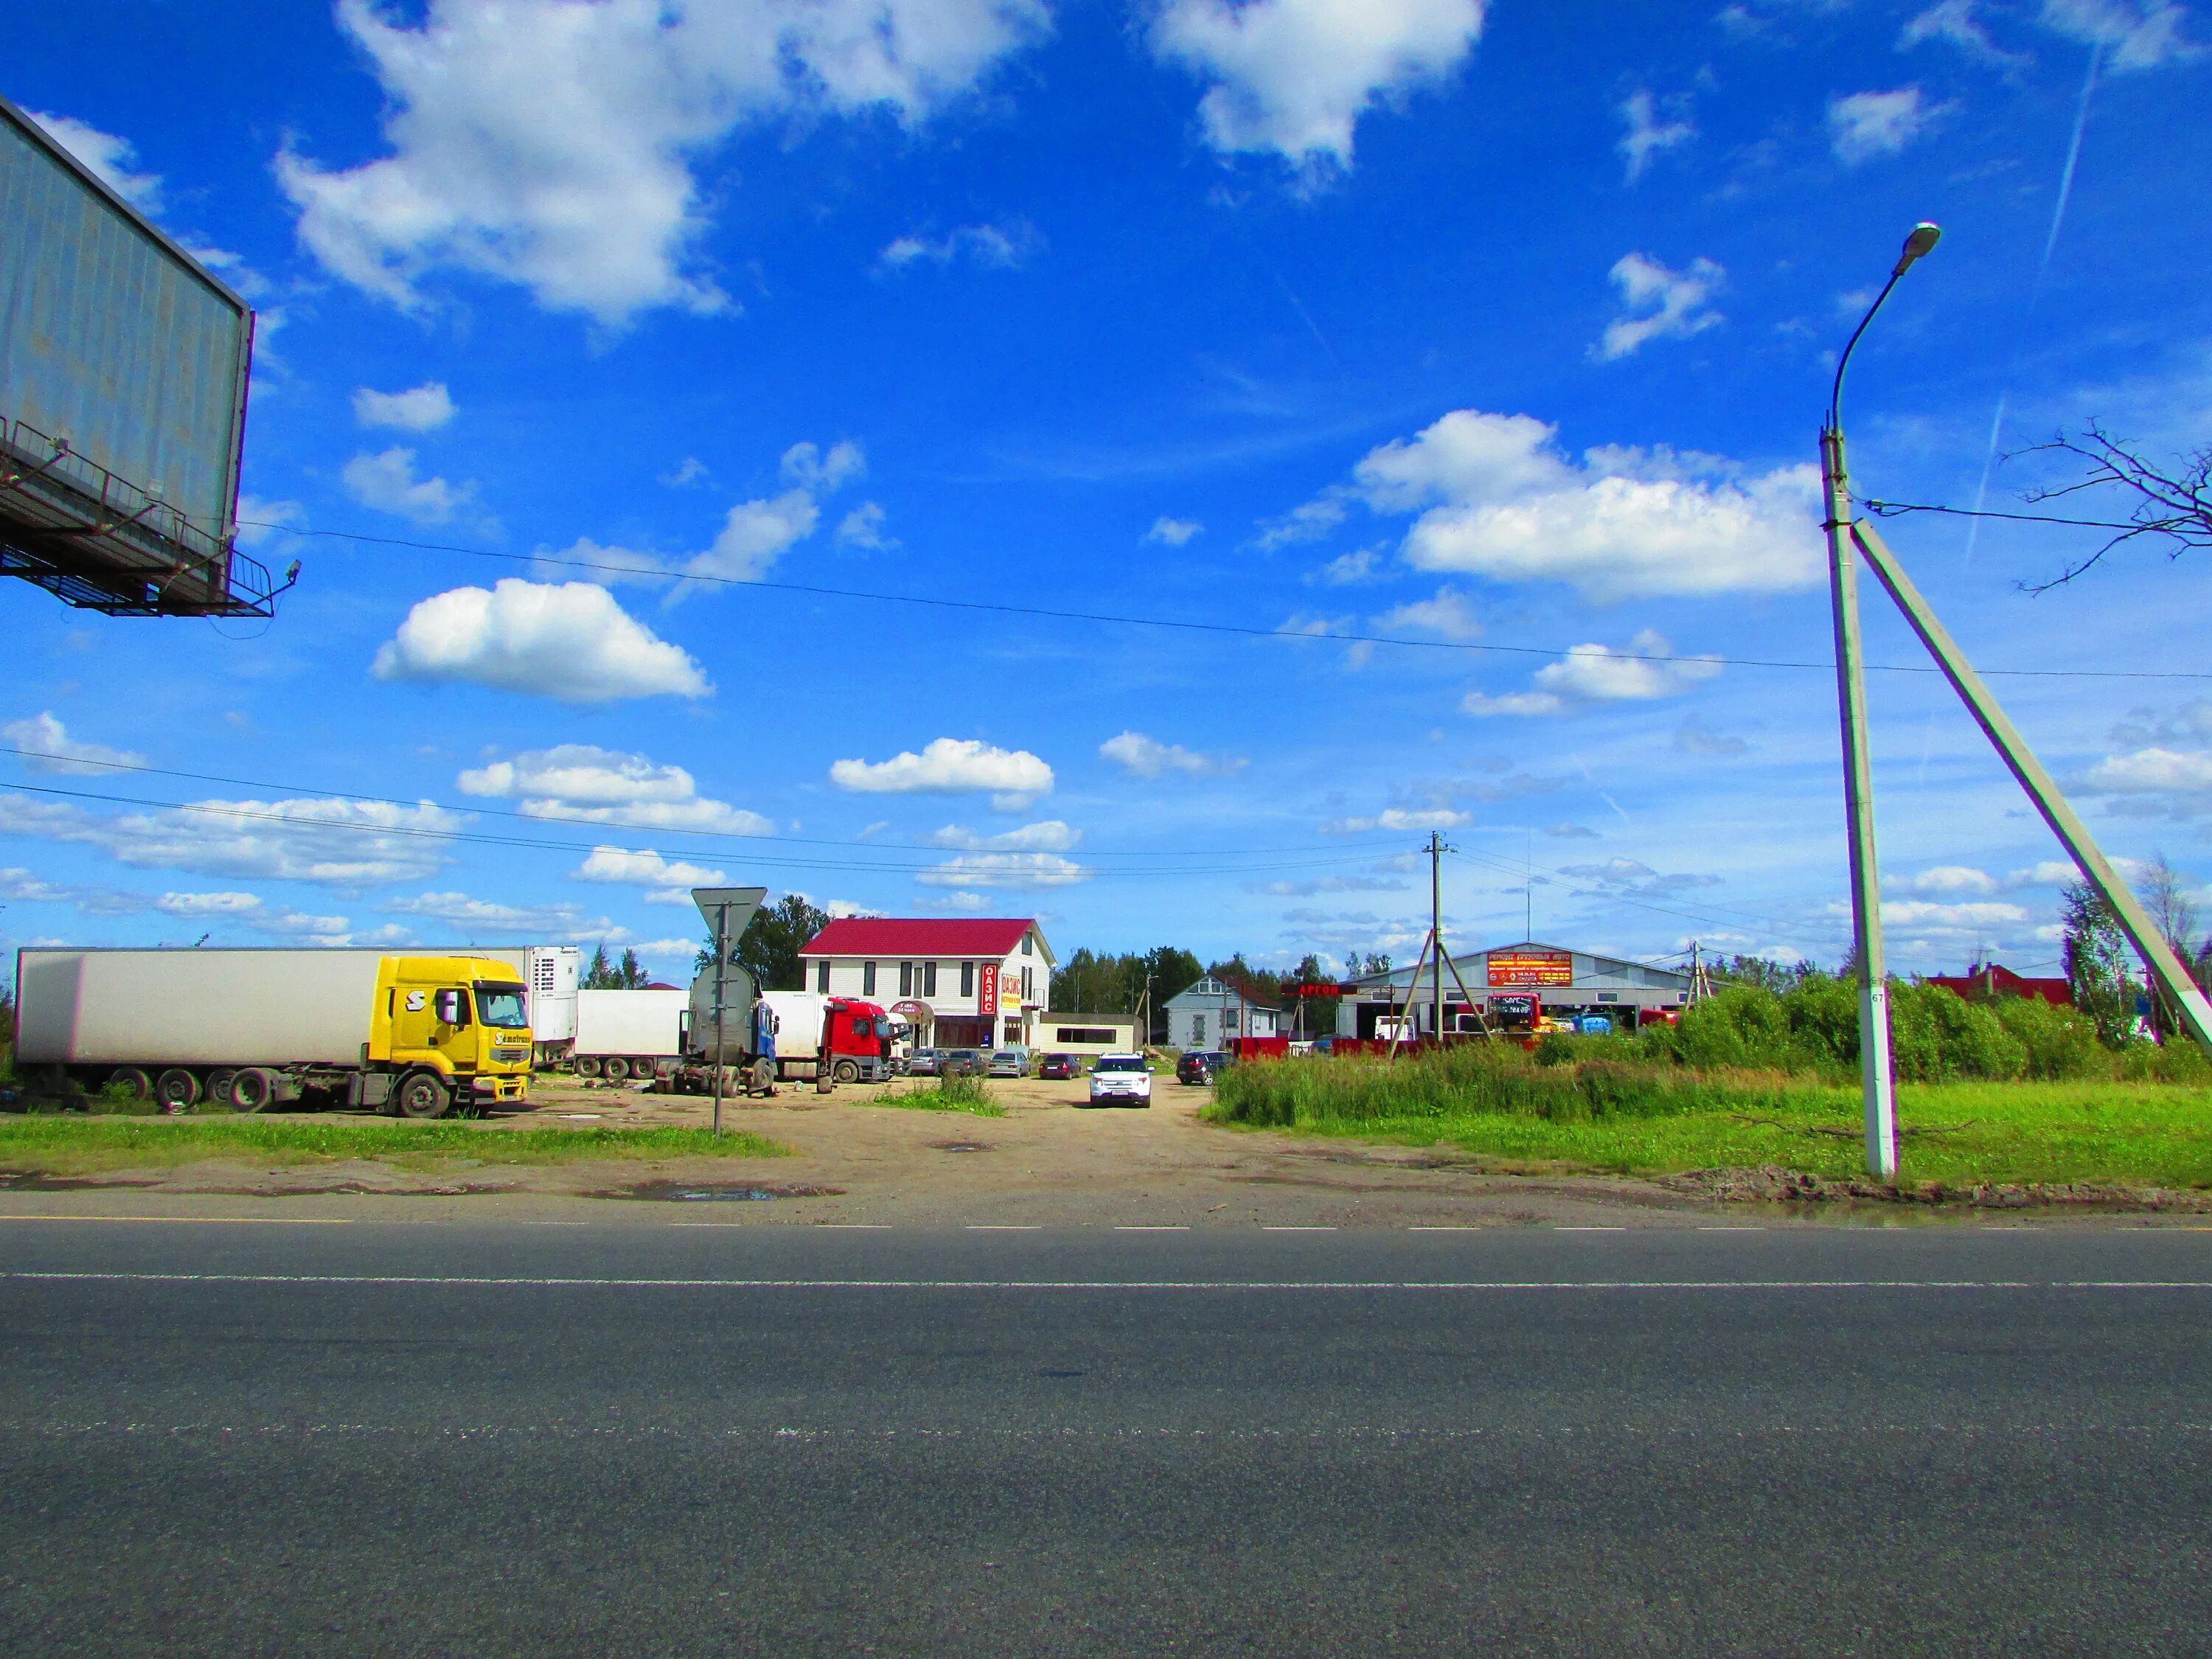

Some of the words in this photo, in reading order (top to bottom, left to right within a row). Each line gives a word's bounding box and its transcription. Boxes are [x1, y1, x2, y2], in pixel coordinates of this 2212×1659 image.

[984, 967, 993, 1011] ОАЗИС
[1002, 975, 1020, 995] ОАЗИС
[1299, 985, 1340, 995] АРГОН
[1872, 994, 1883, 1002] 67
[495, 1032, 530, 1046] Sématrans
